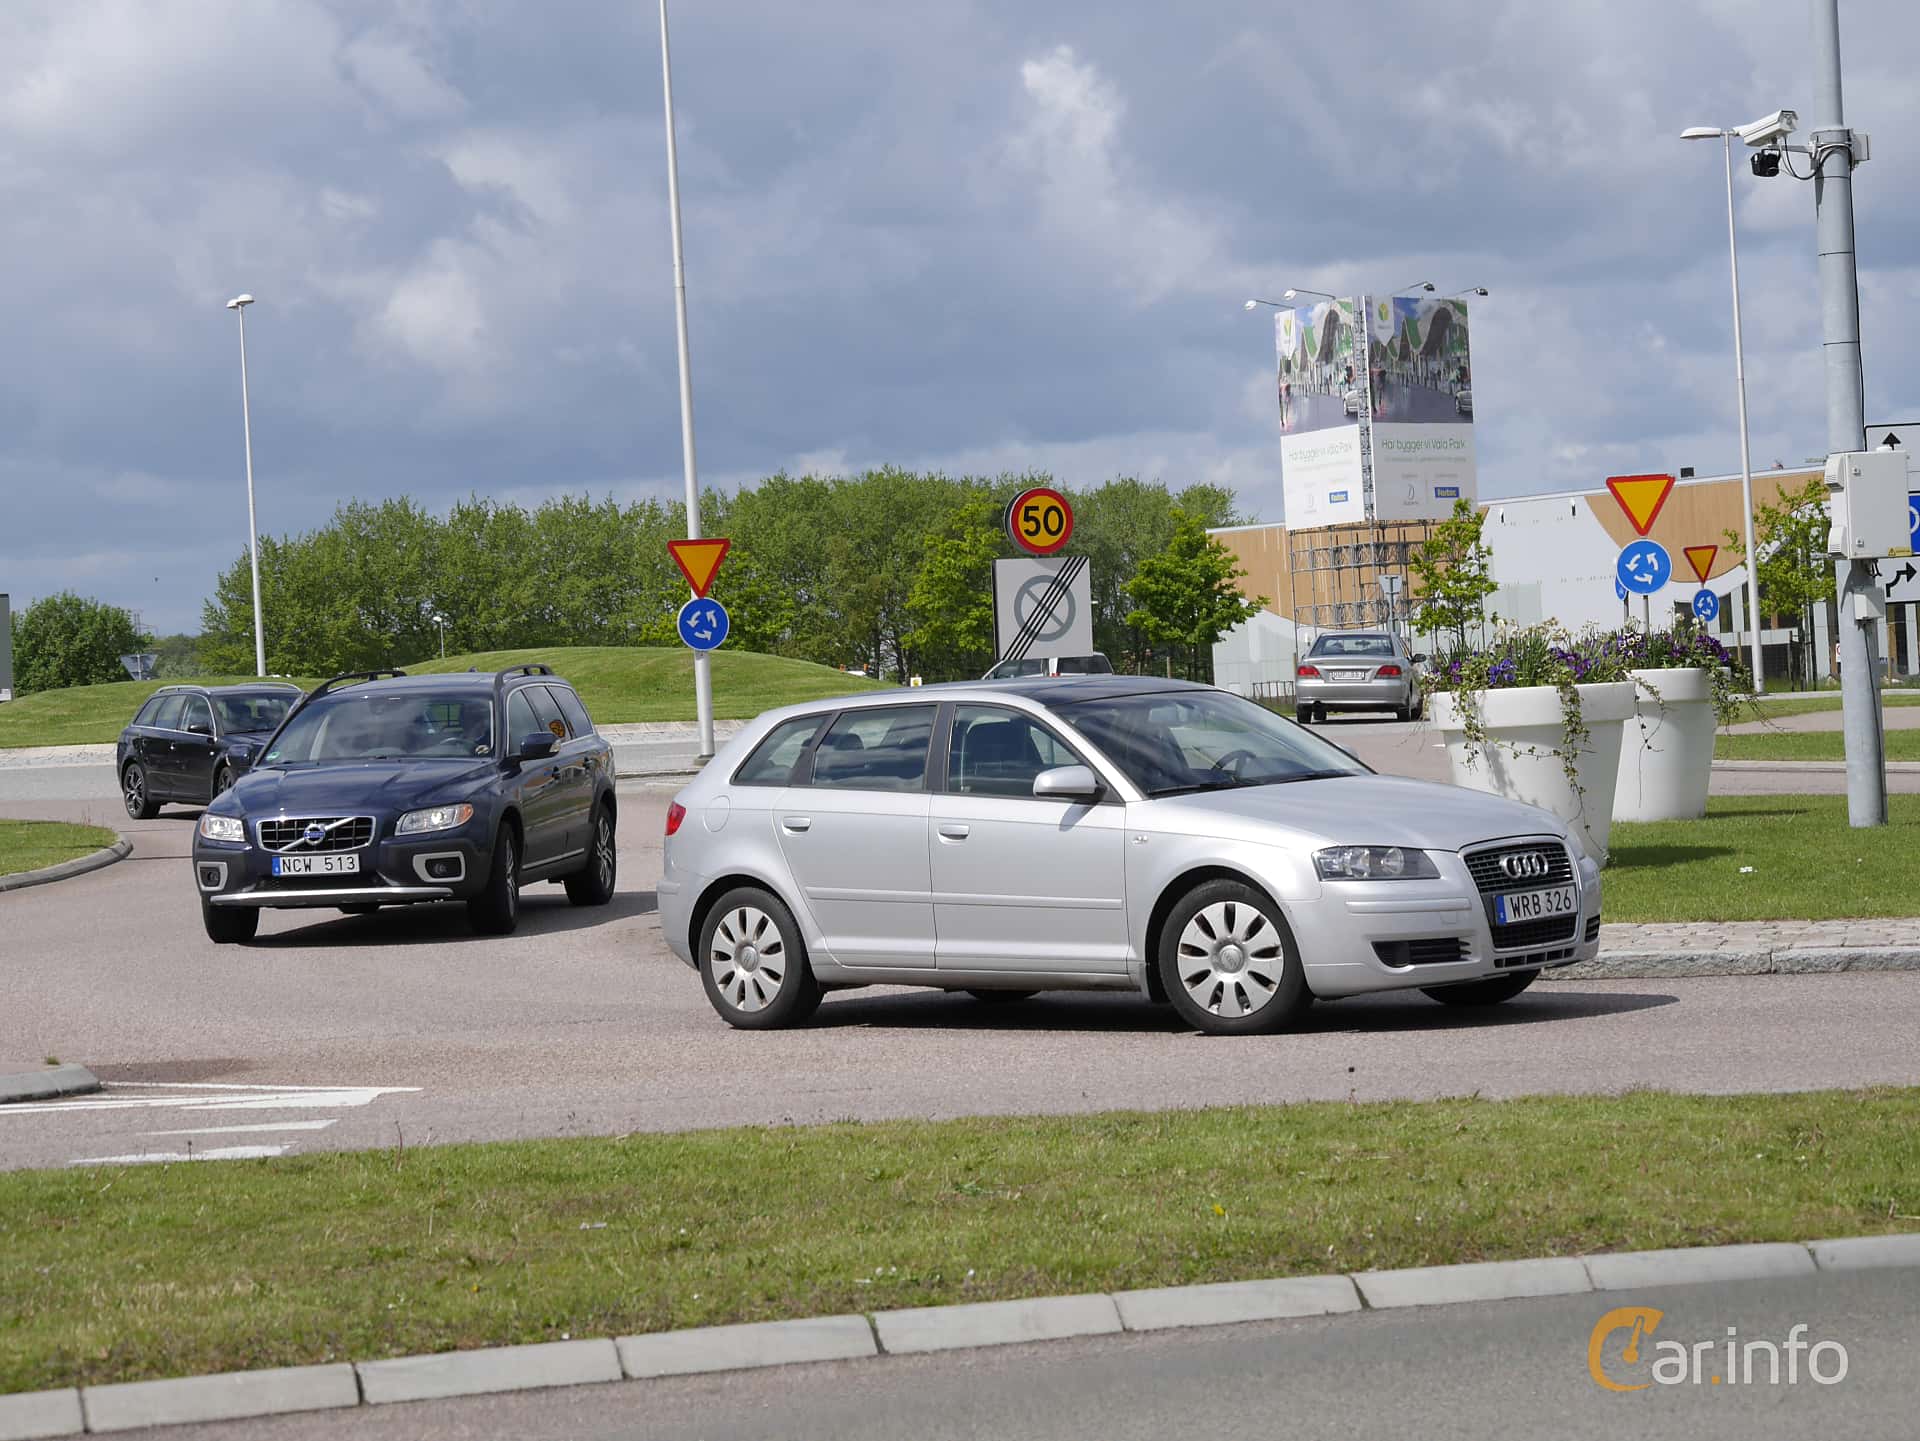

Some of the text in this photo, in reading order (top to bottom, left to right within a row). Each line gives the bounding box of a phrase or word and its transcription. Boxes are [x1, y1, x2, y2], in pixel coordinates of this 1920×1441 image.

[1023, 505, 1064, 537] 50
[282, 856, 355, 873] NCW 513
[1509, 889, 1572, 919] WRB 326
